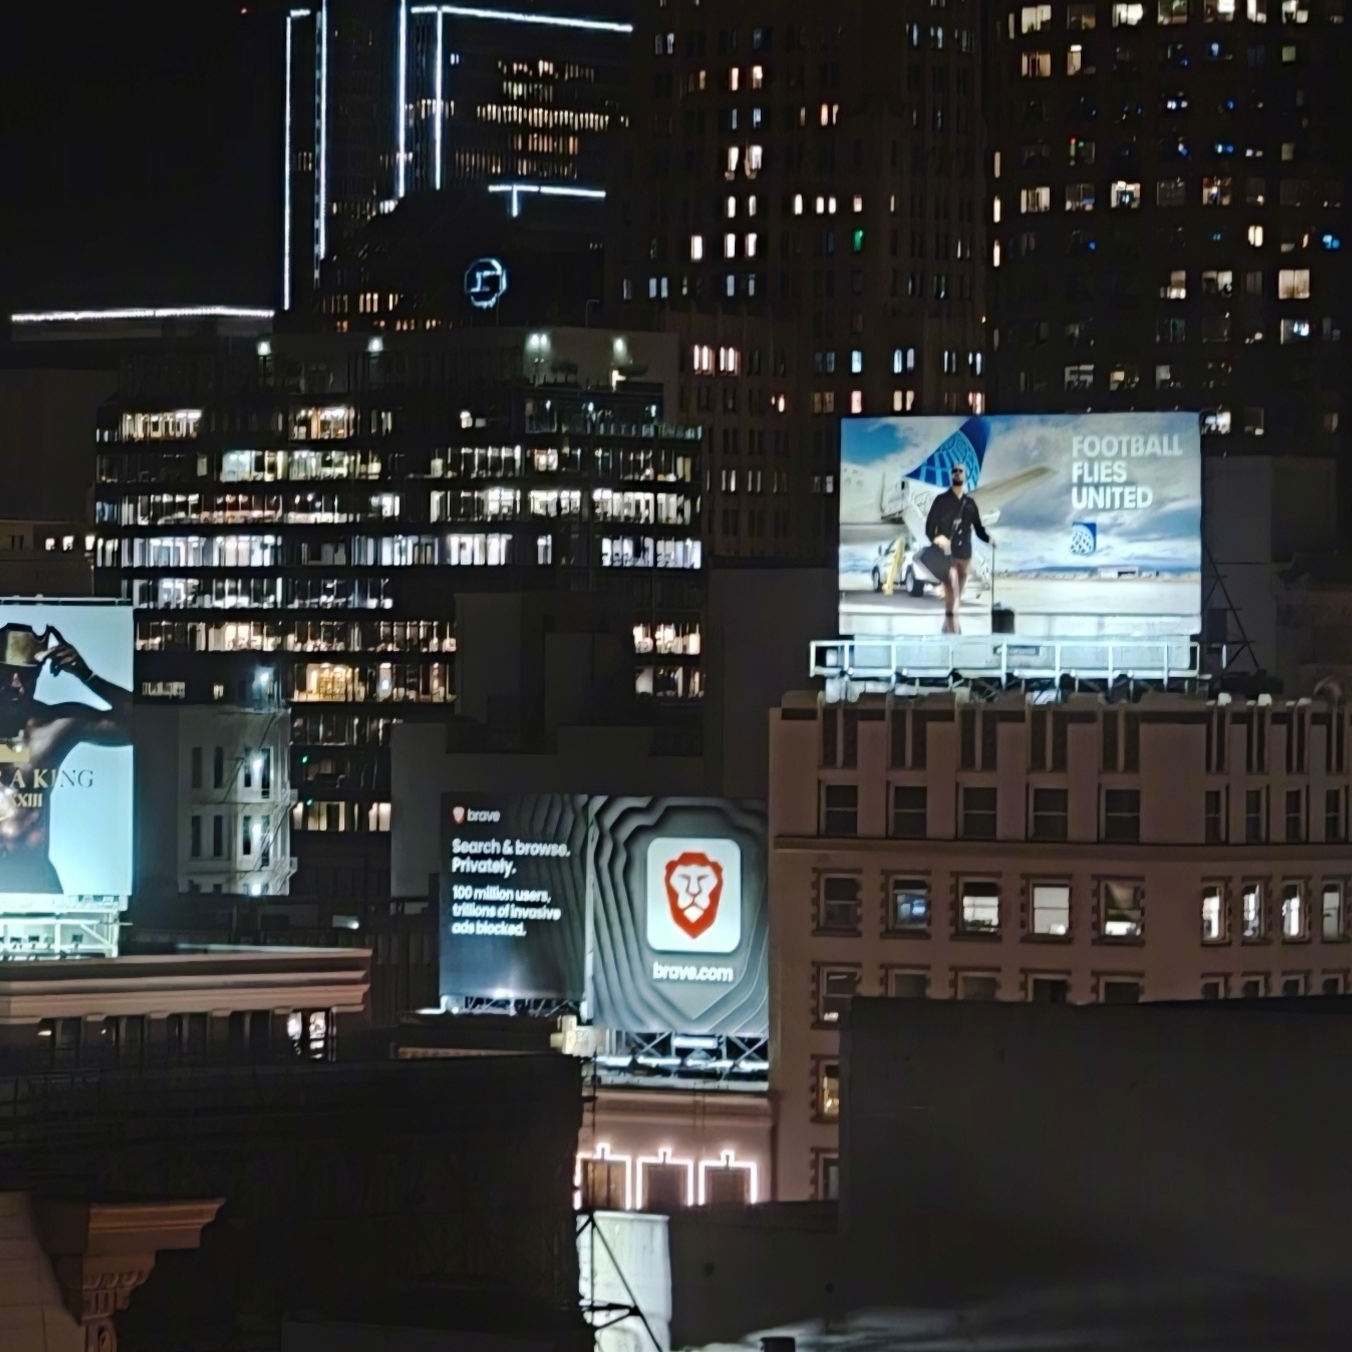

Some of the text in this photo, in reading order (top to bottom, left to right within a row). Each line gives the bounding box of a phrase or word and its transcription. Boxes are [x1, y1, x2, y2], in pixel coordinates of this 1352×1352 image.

[1071, 433, 1183, 458] FOOTBALL
[1071, 460, 1127, 484] FLIES
[1071, 485, 1154, 510] UNITED
[9, 768, 26, 788] A
[33, 768, 94, 788] KING
[467, 808, 501, 822] brave
[452, 838, 571, 857] Search & browse.
[451, 856, 517, 879] Privately.
[452, 885, 551, 904] 100 million users,
[452, 902, 561, 921] trillions of invasive
[451, 920, 527, 937] ads blocked.
[652, 961, 733, 982] brave.com
